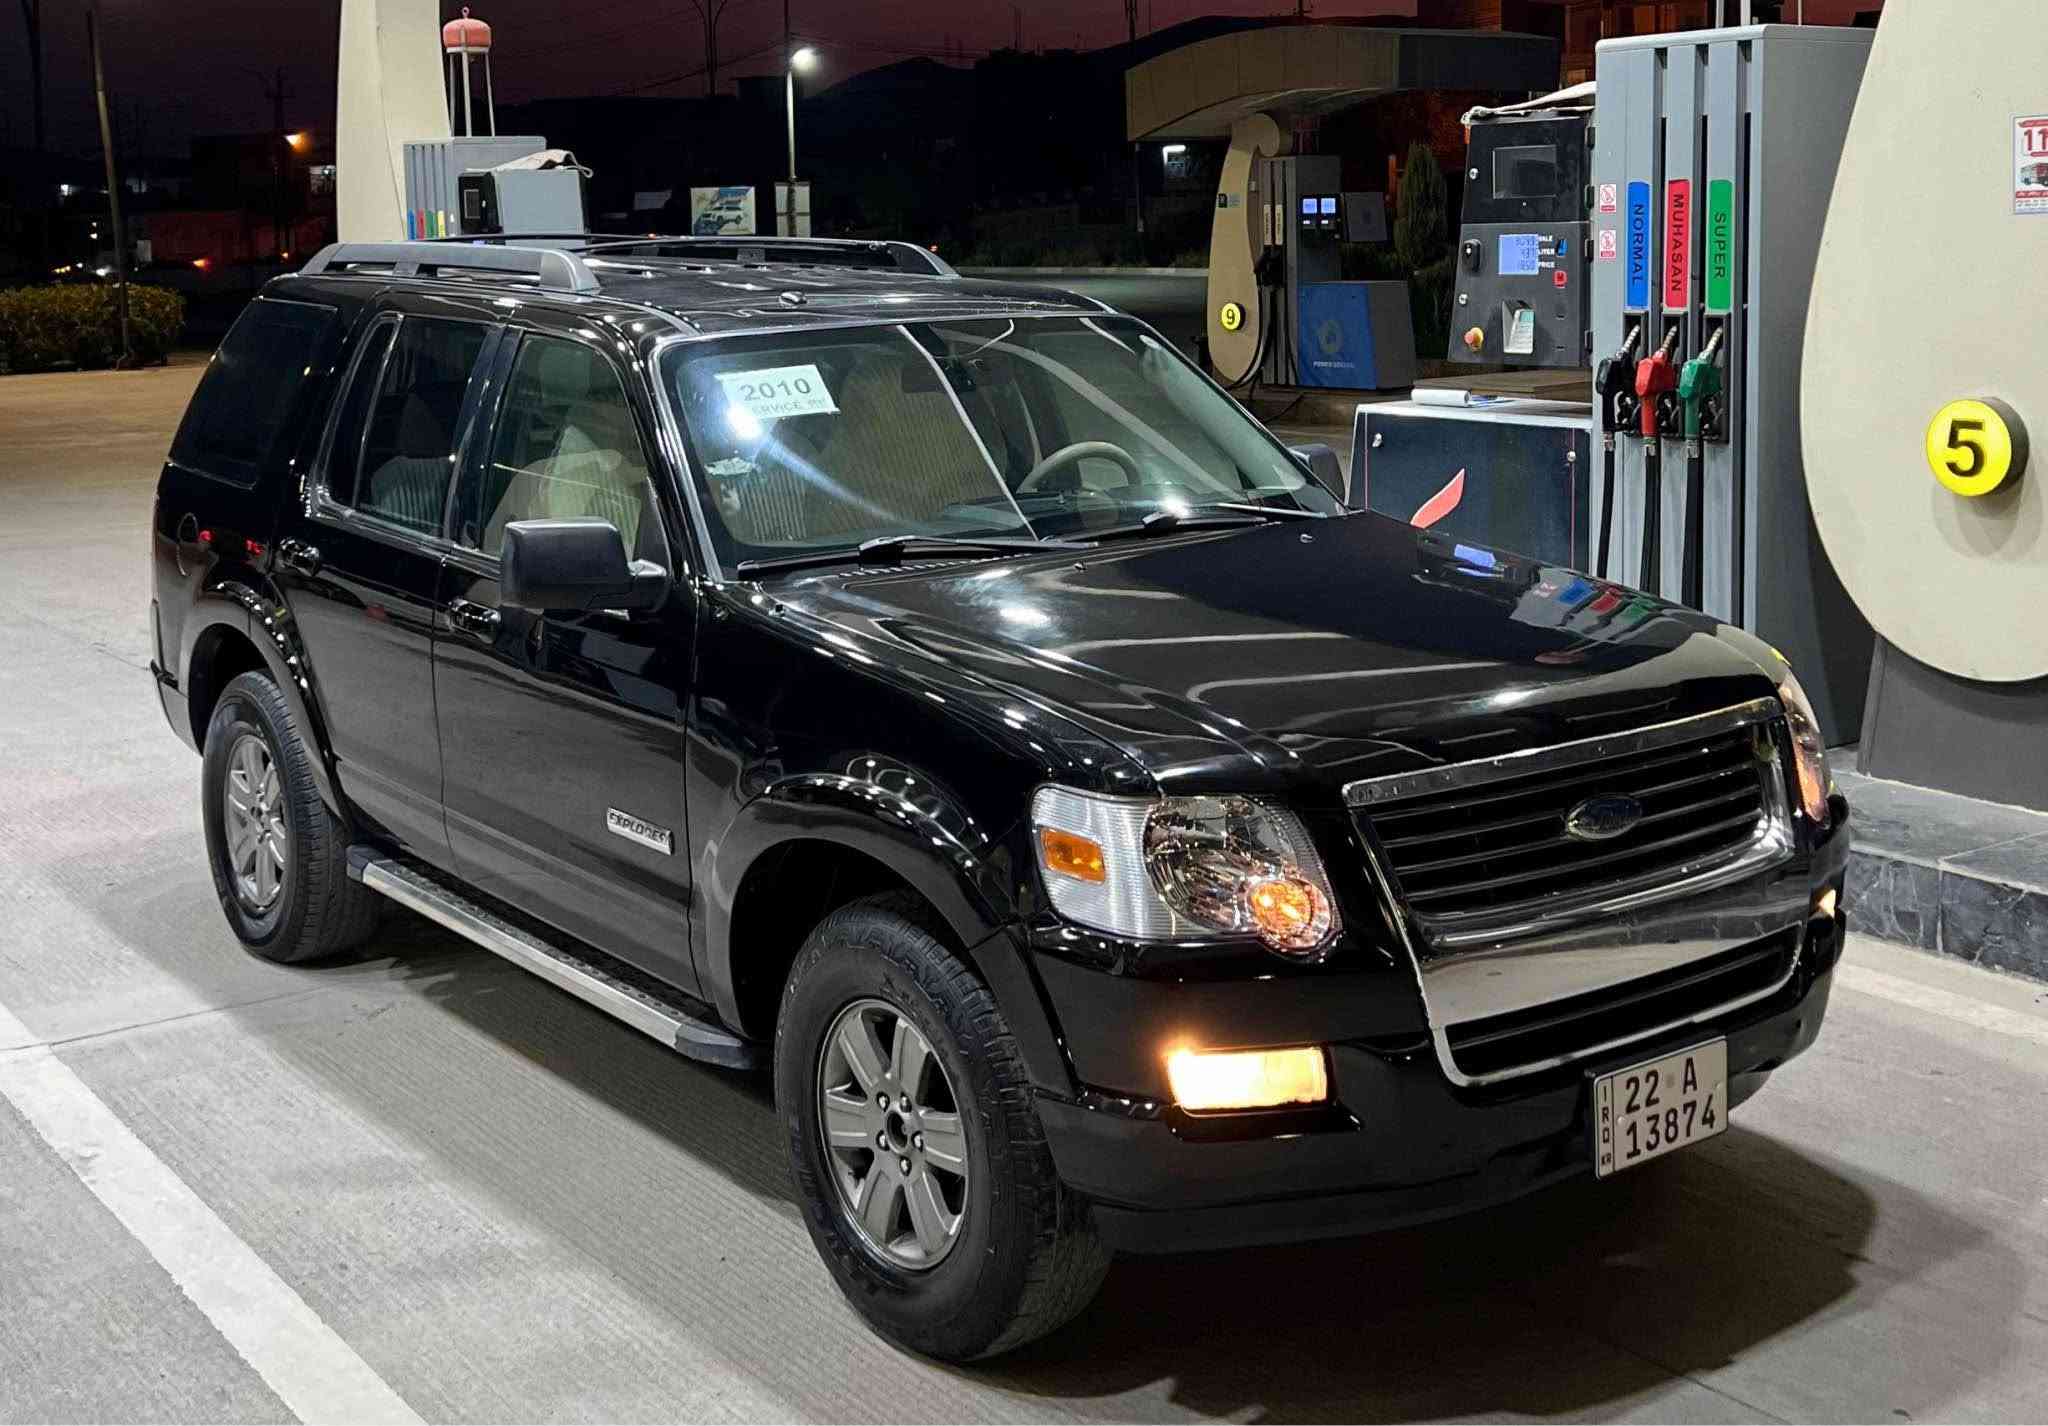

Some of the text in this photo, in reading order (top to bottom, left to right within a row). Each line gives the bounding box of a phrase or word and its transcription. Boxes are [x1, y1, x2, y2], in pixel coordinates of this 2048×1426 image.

[2024, 128, 2048, 151] 11
[1632, 204, 1644, 287] NORMAL
[1671, 193, 1684, 292] MUHASAN
[1714, 212, 1726, 279] SUPER
[1226, 309, 1235, 325] 9
[741, 378, 811, 401] 2010
[1946, 419, 1984, 477] 5
[1625, 1057, 1698, 1114] 22 A
[1626, 1093, 1716, 1160] 13874
